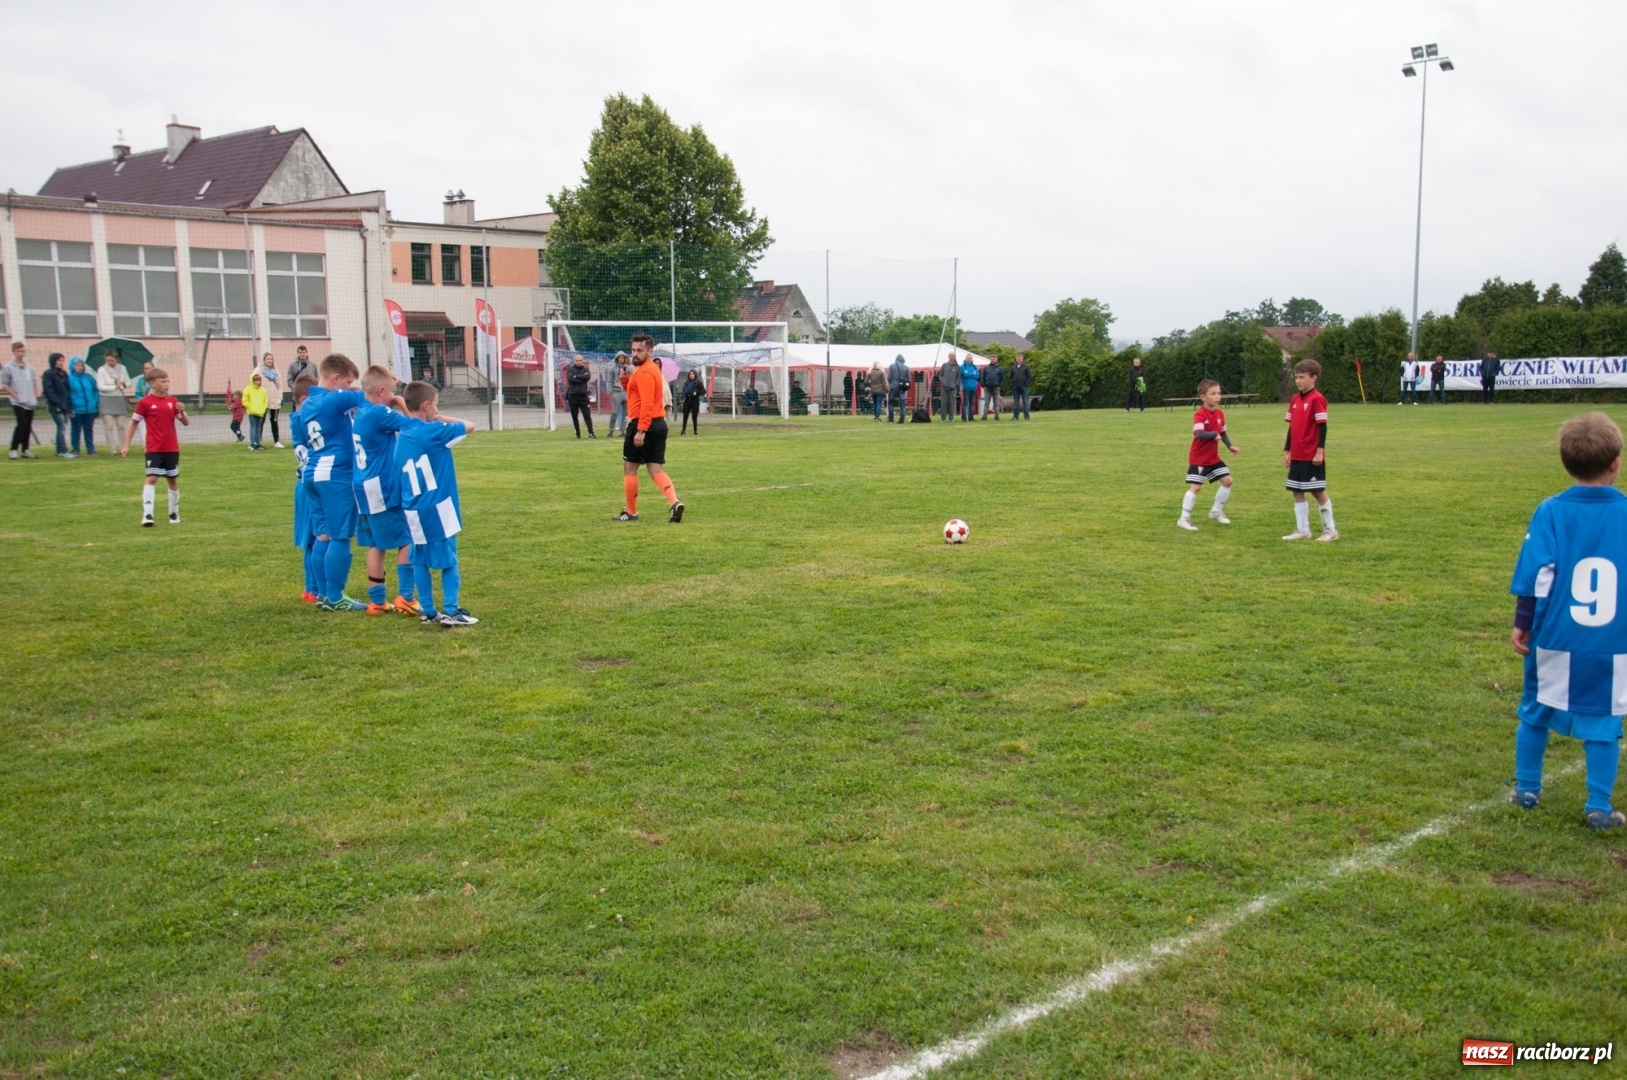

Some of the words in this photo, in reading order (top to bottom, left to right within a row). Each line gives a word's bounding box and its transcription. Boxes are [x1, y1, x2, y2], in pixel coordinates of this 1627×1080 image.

[1444, 360, 1556, 377] SERCZNIE
[1562, 358, 1627, 375] WITAM
[1536, 375, 1596, 386] raciborskim
[307, 420, 325, 451] 6
[352, 433, 367, 470] 5
[402, 453, 438, 496] 11
[1570, 557, 1618, 627] 9
